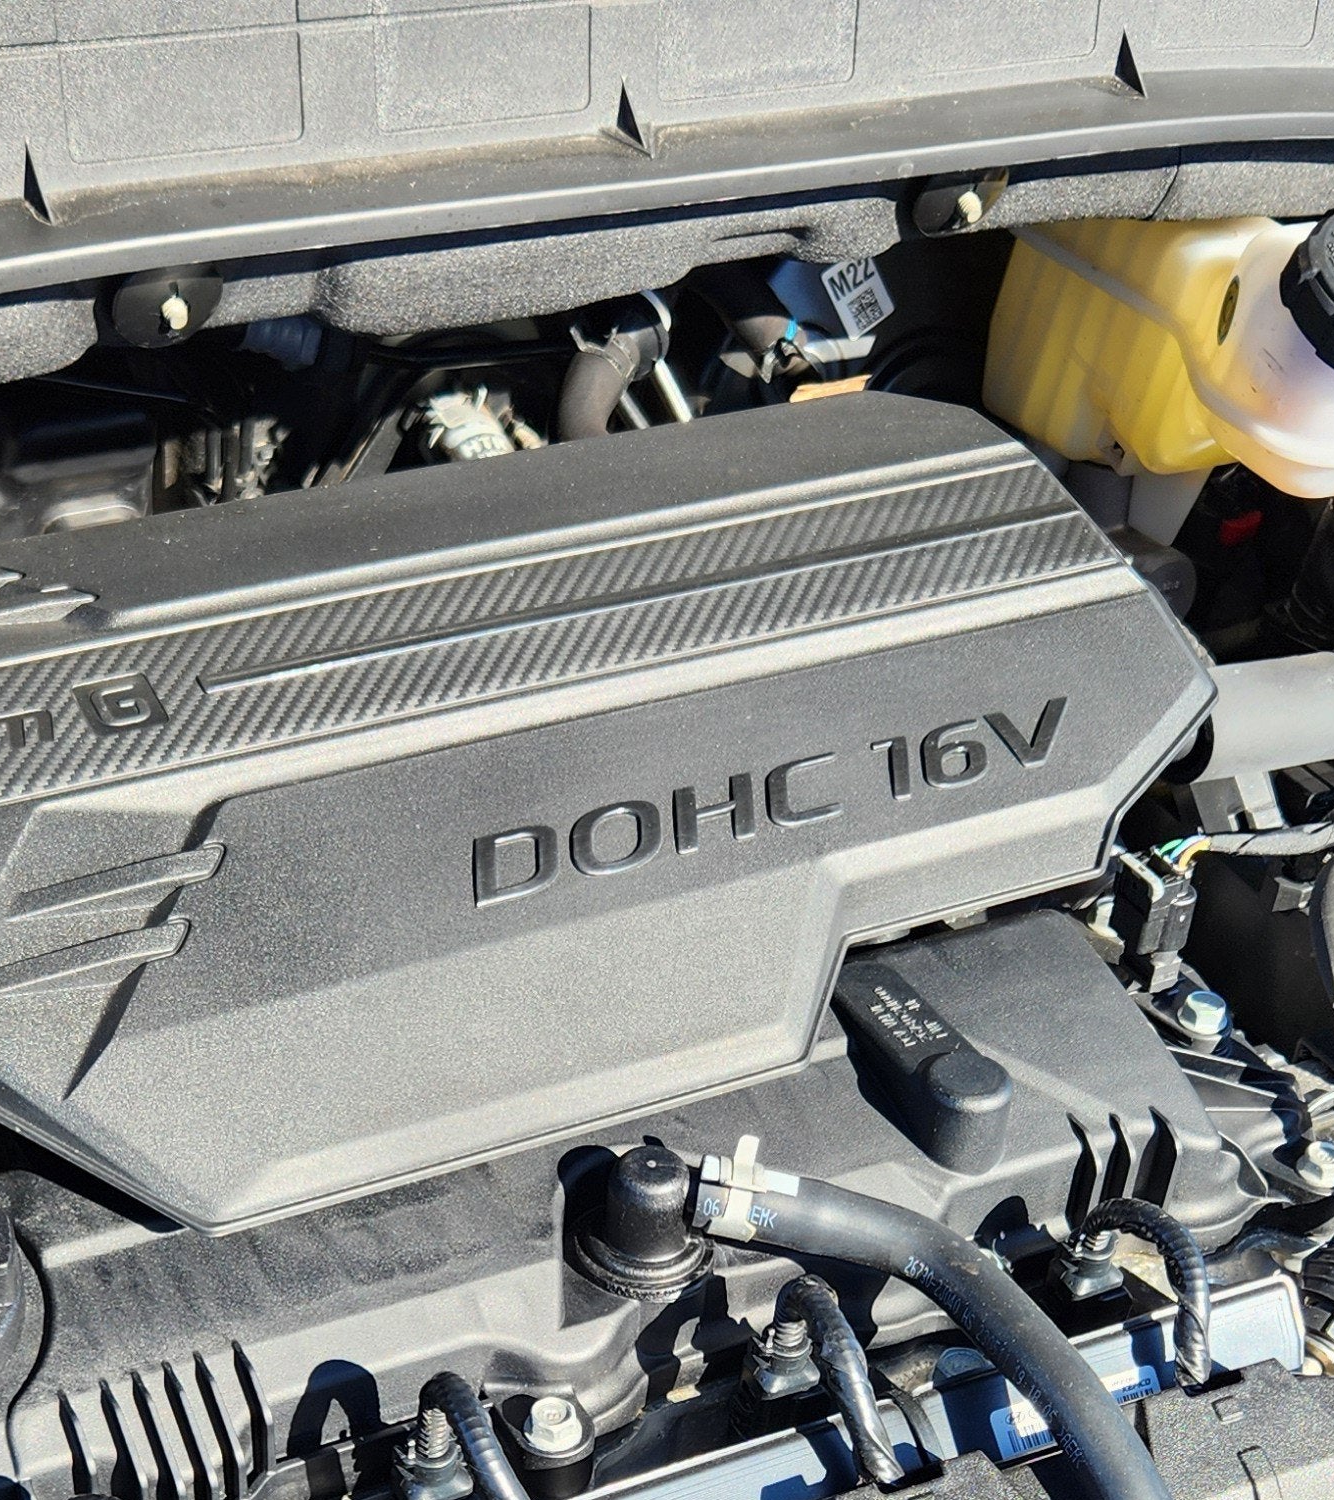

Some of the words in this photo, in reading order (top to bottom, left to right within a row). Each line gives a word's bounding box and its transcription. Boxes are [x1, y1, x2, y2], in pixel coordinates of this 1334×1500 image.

[827, 258, 875, 301] M22
[472, 750, 845, 908] DOHC
[869, 697, 1068, 801] 16V
